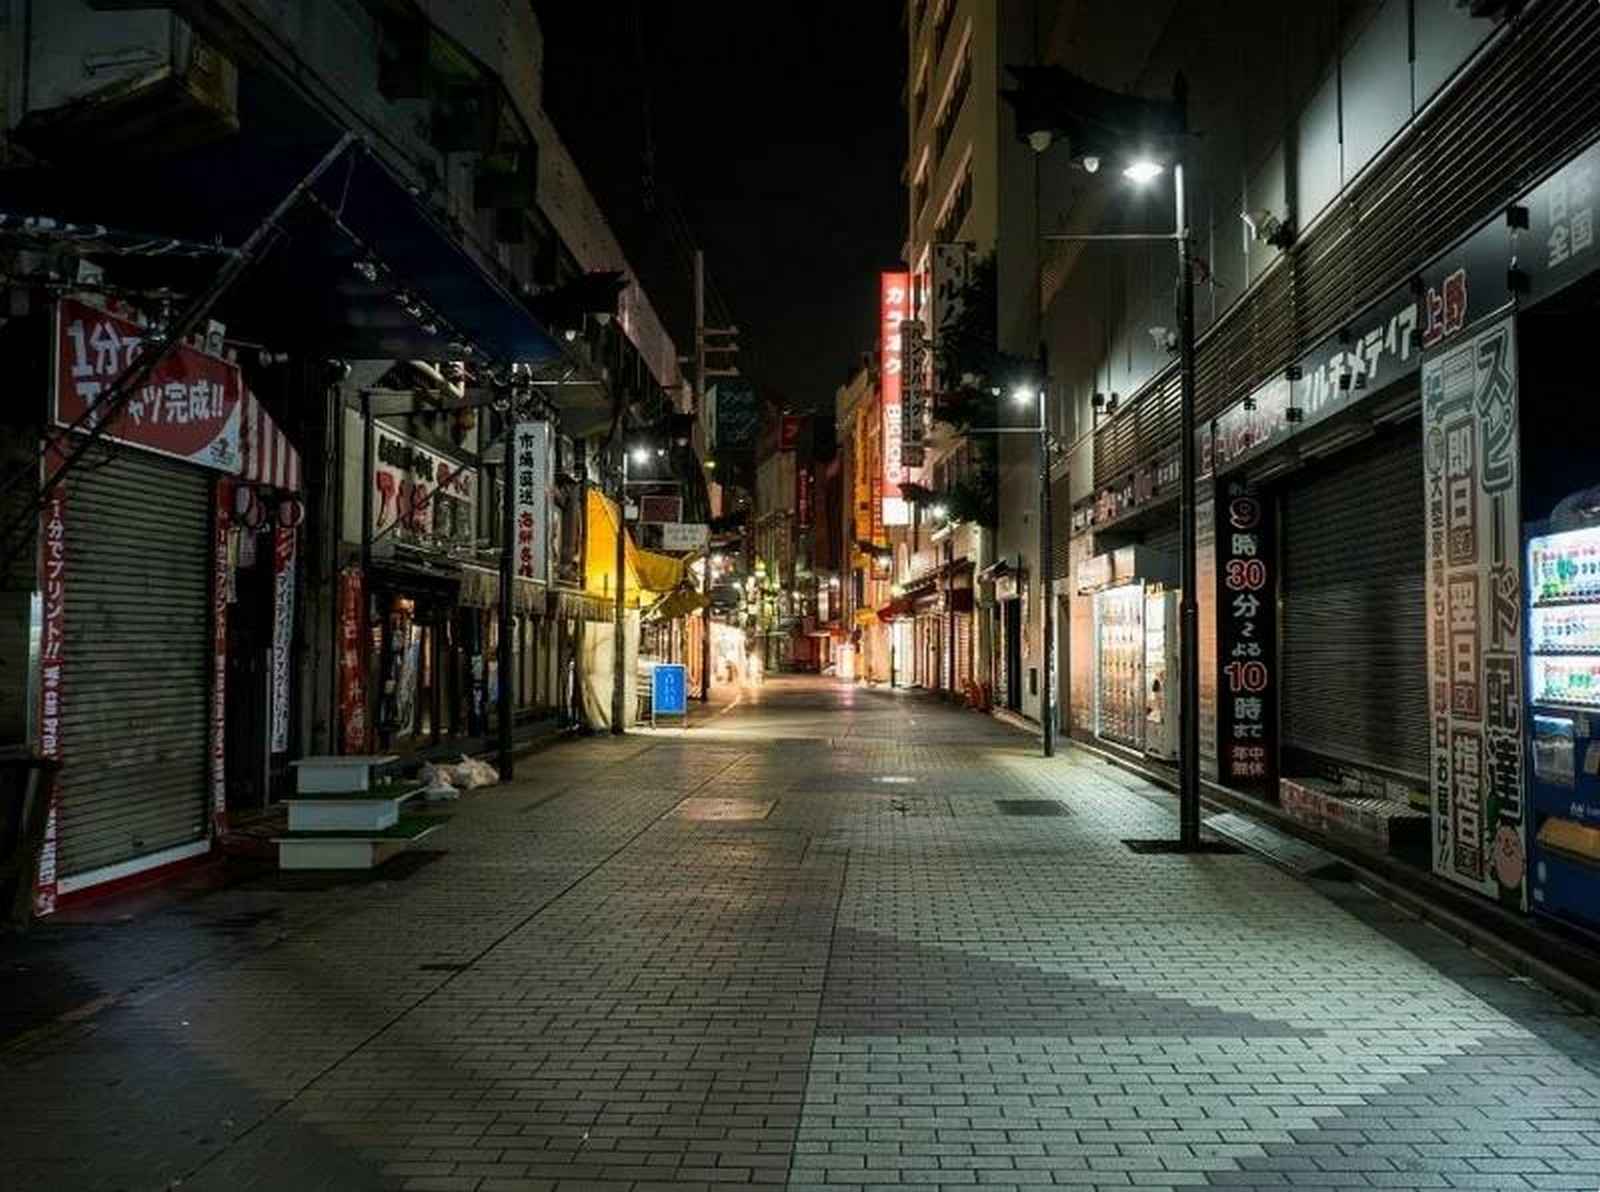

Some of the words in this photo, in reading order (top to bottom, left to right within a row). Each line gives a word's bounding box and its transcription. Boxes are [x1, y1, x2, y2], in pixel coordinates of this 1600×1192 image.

[1547, 206, 1593, 269] 全国
[75, 378, 225, 429] Tャツ完成!!
